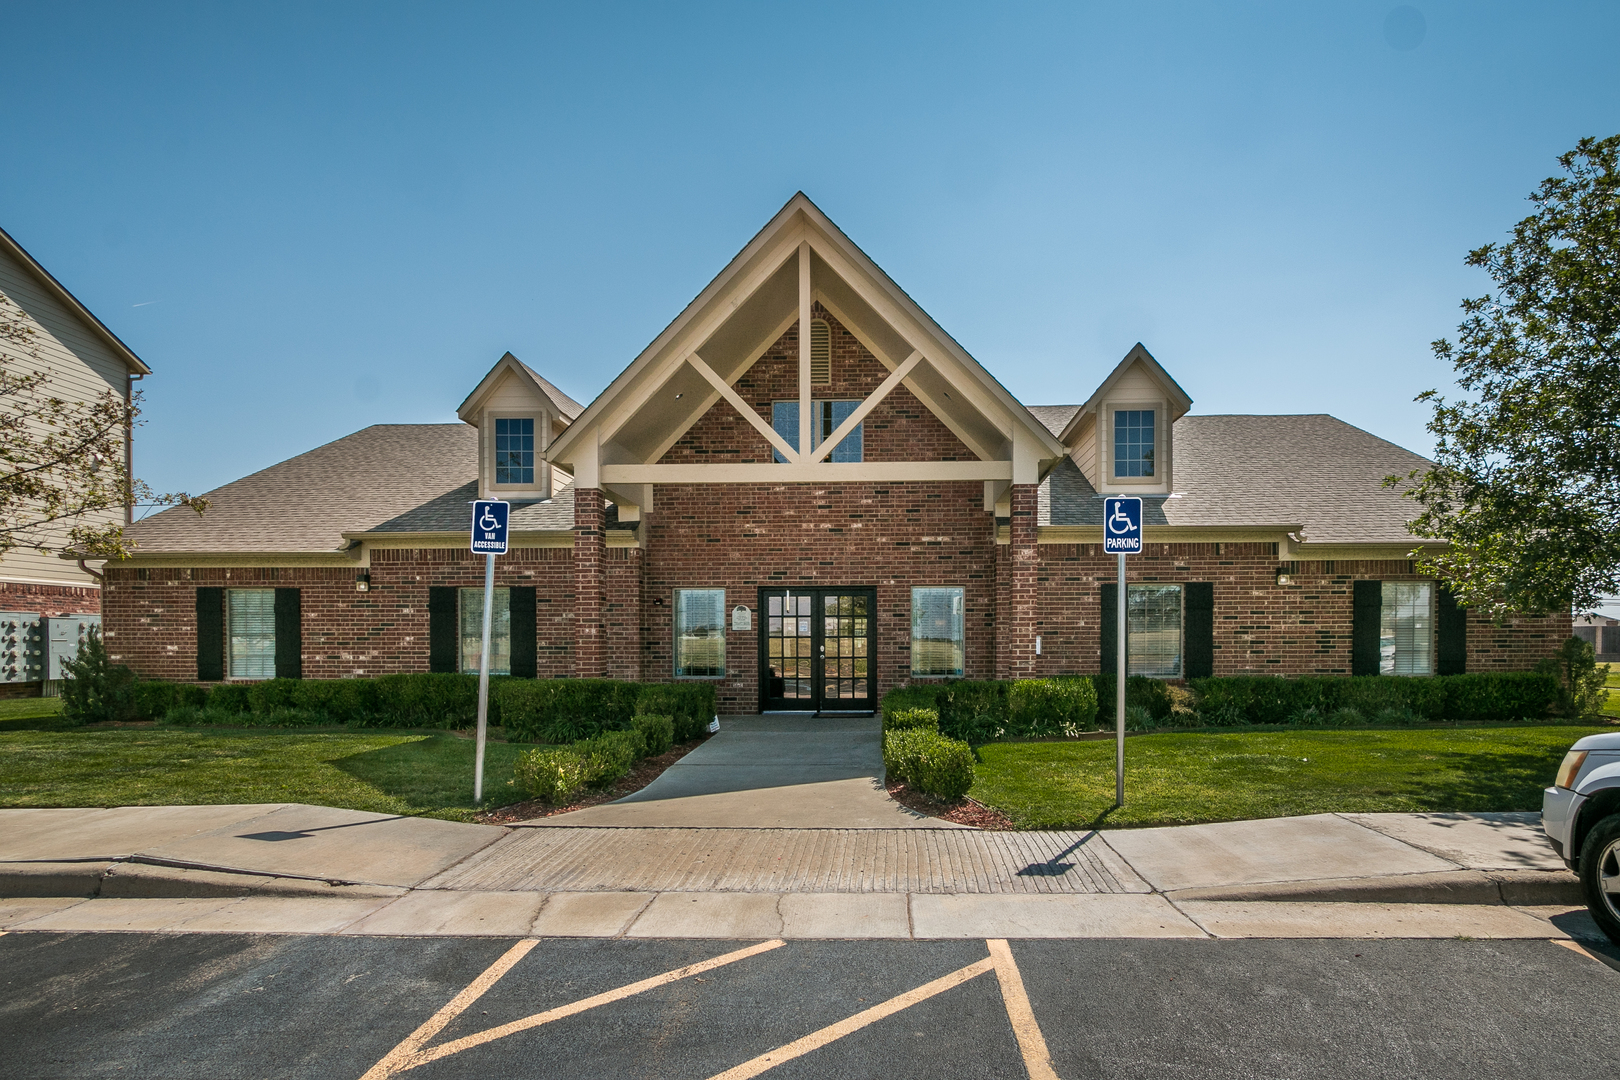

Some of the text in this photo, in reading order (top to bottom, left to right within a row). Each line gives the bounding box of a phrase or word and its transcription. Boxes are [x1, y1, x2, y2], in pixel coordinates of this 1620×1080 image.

[485, 532, 496, 540] VAN
[474, 541, 505, 549] ACCESSIBLE
[1107, 538, 1139, 548] PARKING
